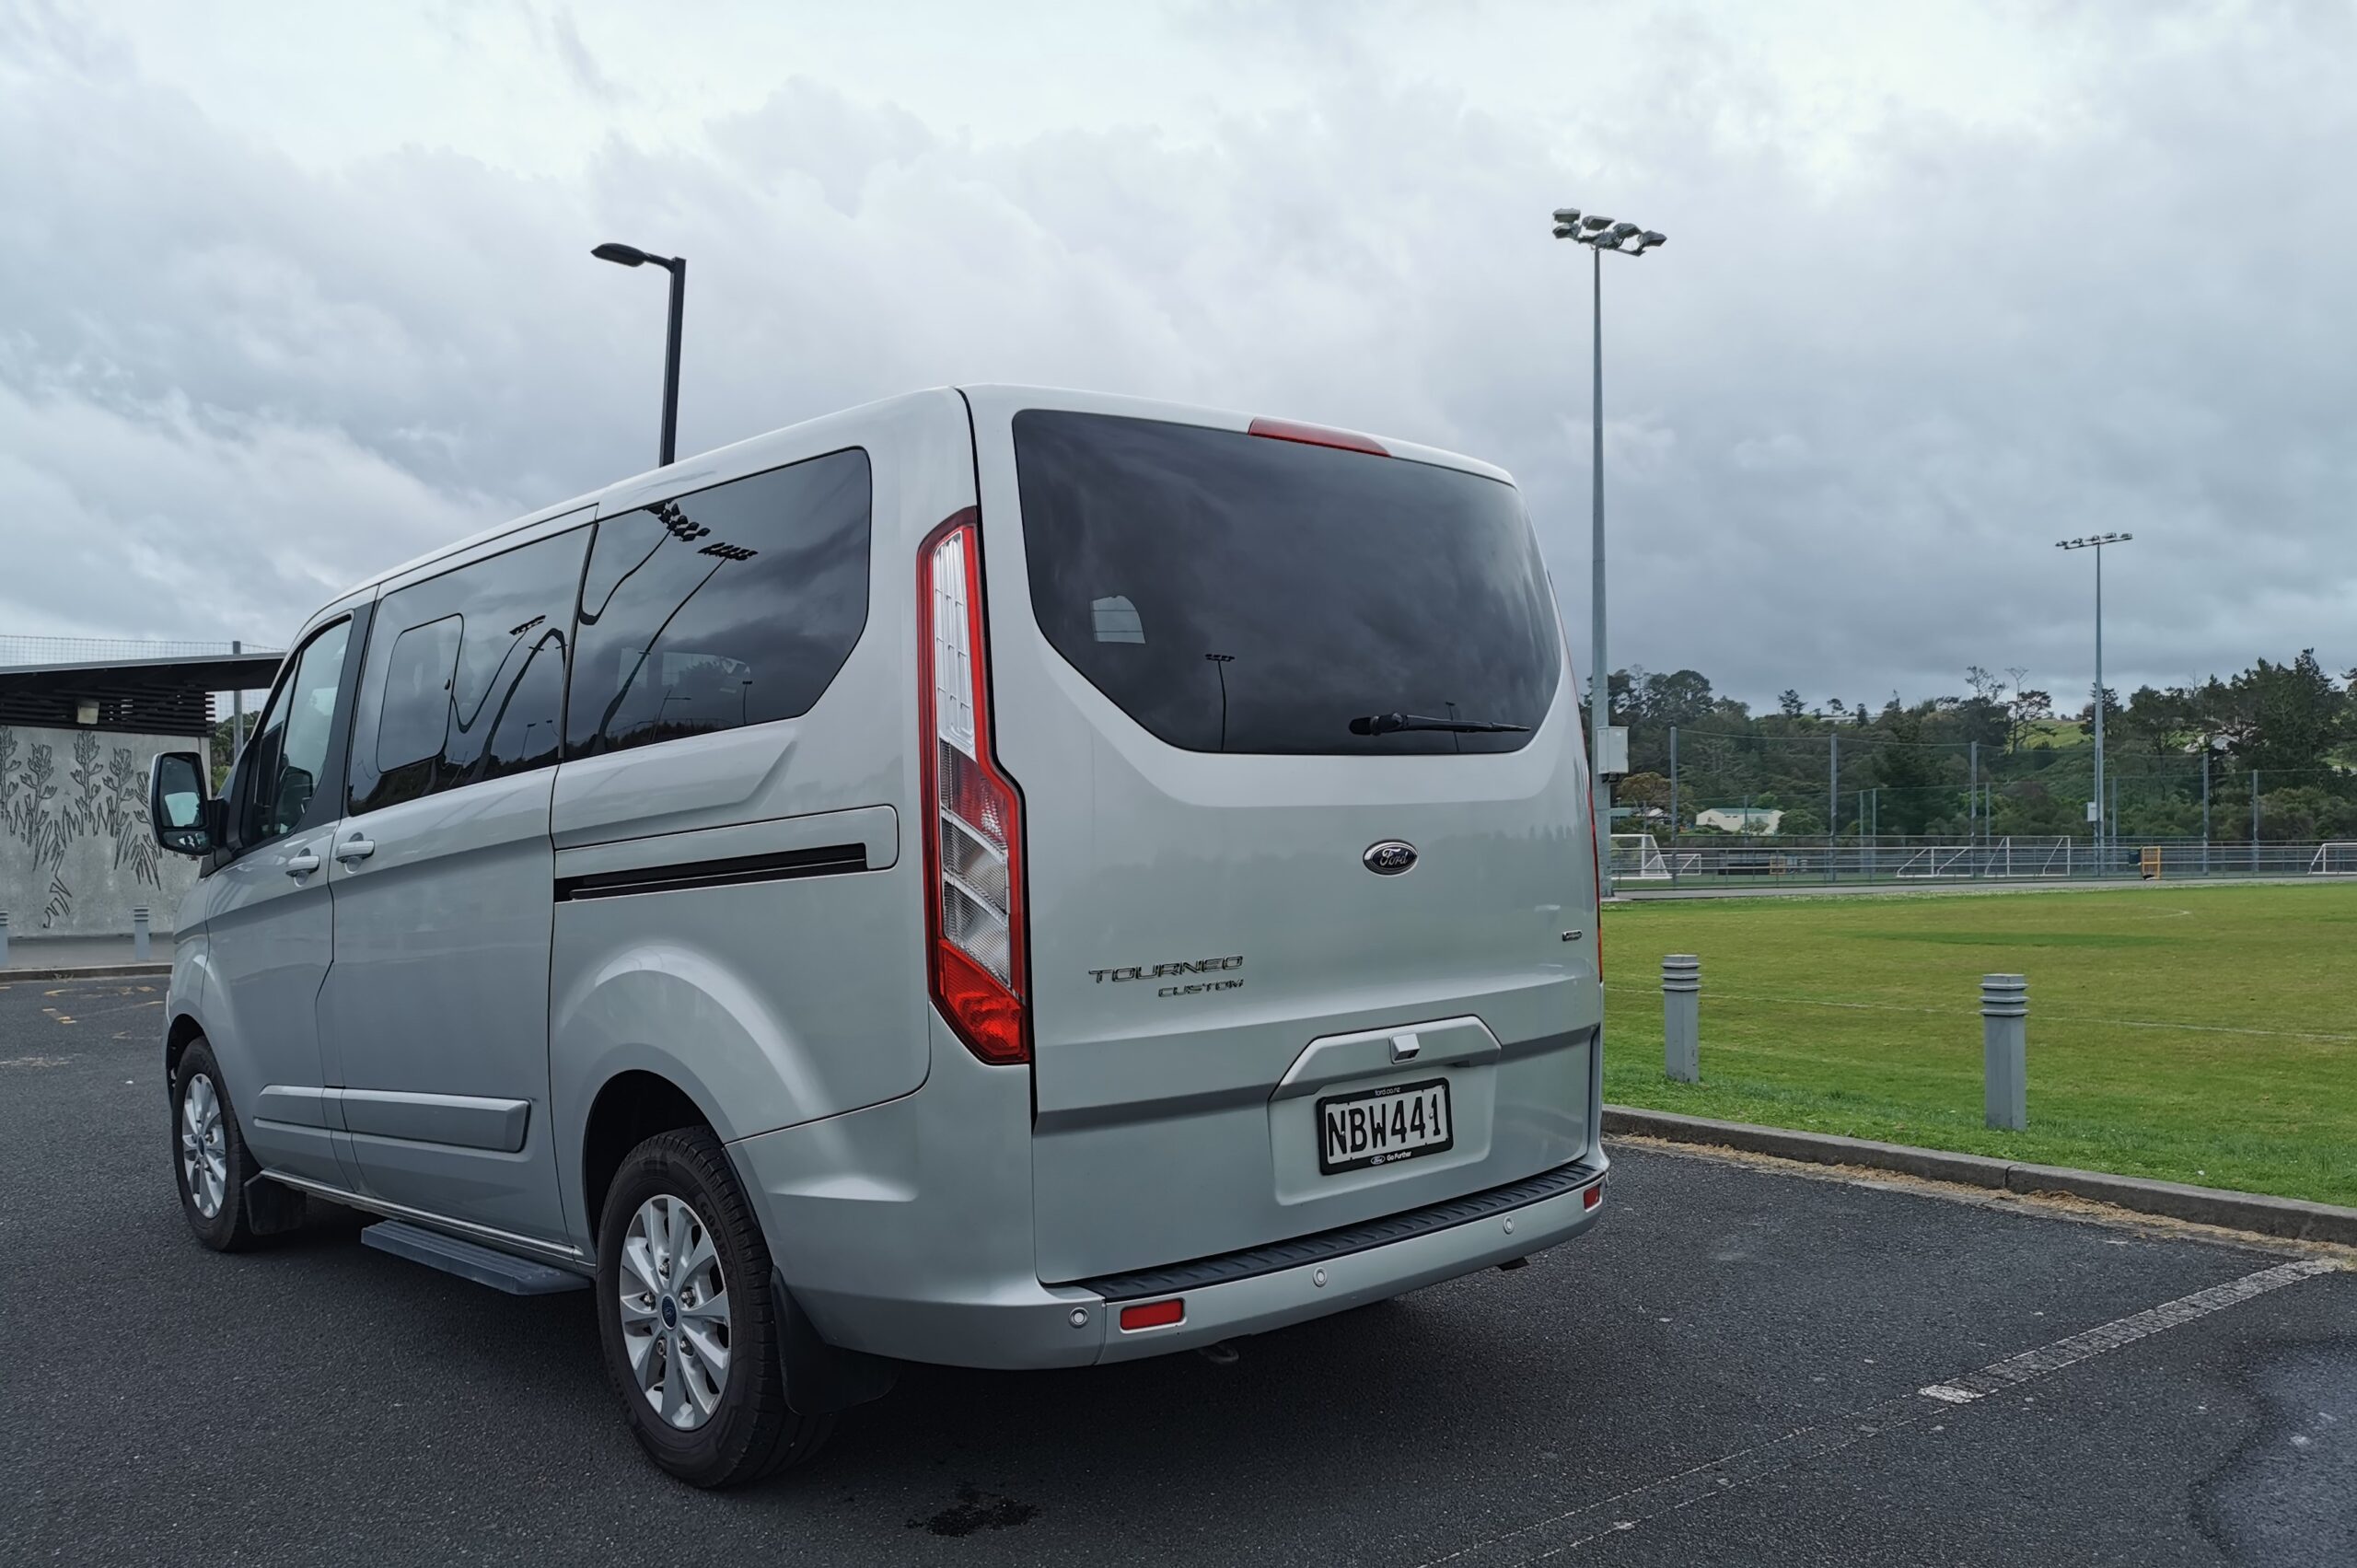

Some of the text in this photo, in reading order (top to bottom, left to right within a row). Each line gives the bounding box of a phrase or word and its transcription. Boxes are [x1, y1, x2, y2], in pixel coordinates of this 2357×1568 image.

[1379, 847, 1409, 866] Ford
[1088, 955, 1244, 984] TOURNEO
[1158, 979, 1244, 997] CUSTOM
[1328, 1093, 1441, 1156] NBW441
